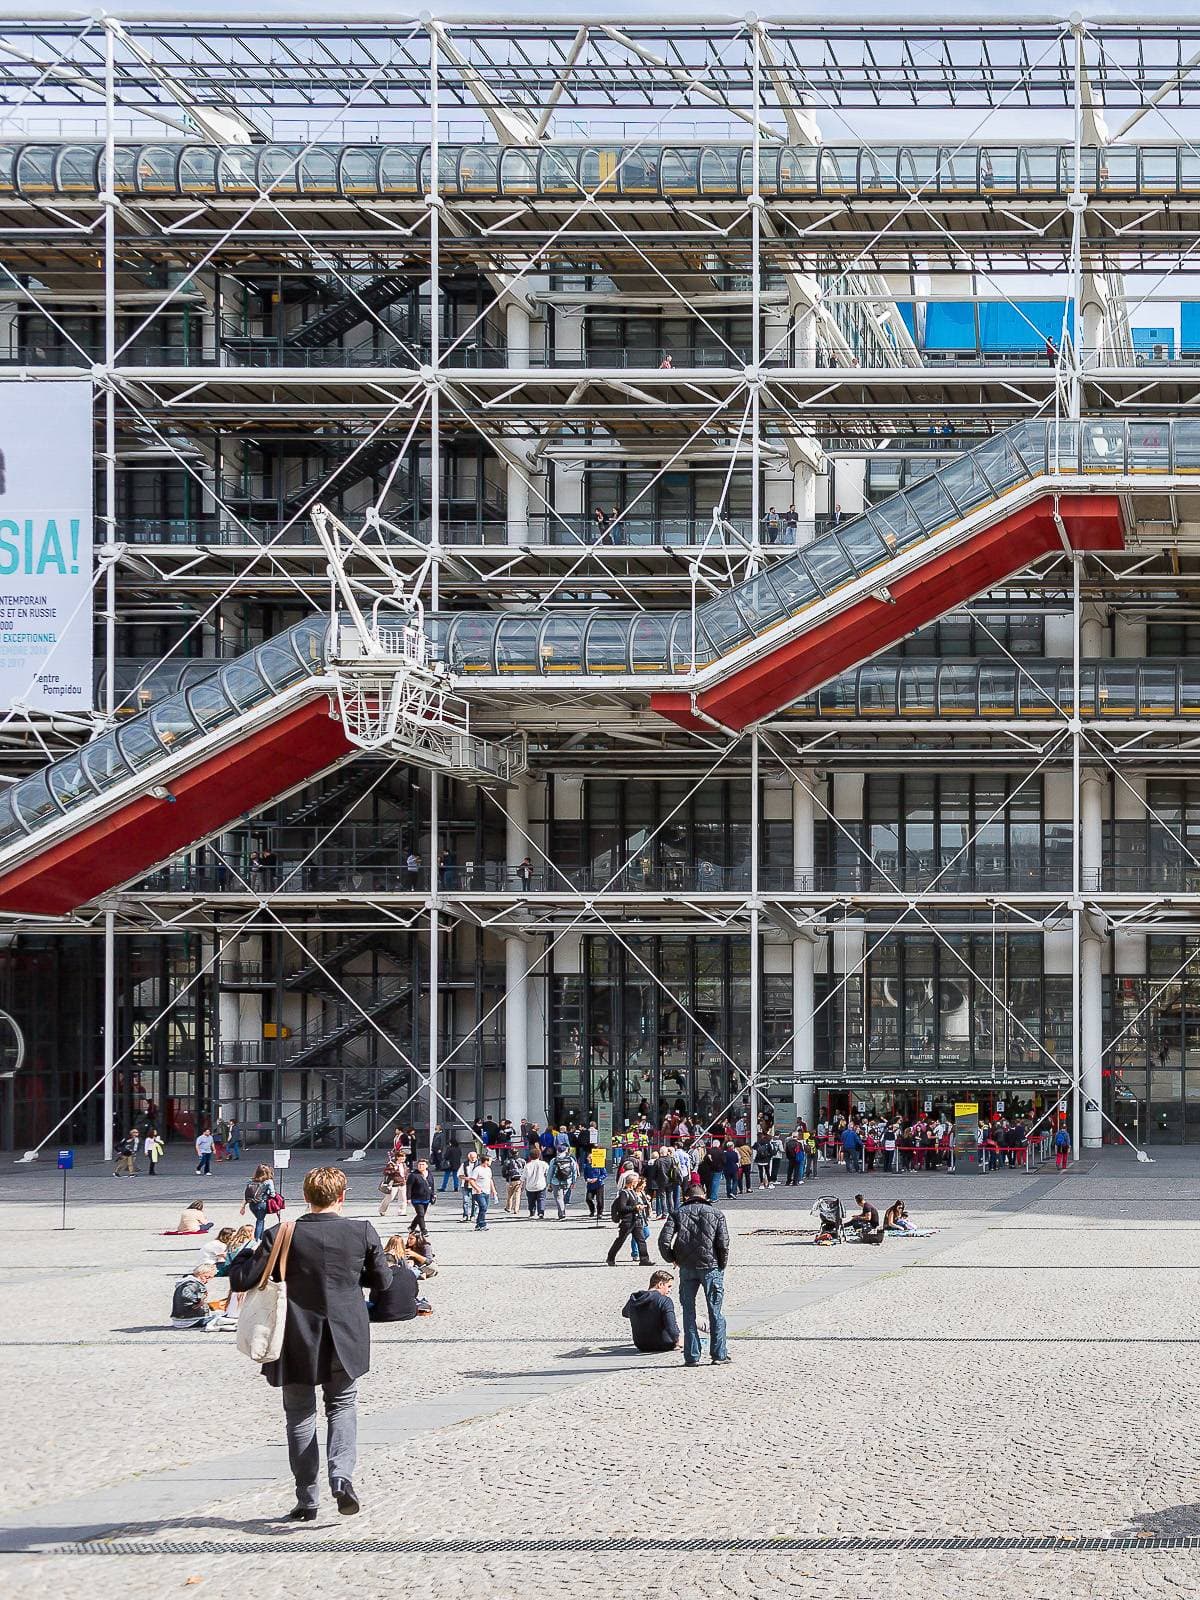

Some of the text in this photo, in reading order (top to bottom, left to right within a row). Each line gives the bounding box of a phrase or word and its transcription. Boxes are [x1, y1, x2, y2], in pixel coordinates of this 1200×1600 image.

[29, 608, 57, 618] RUSSIE
[3, 633, 57, 643] EXCEPTIONNEL
[43, 684, 82, 697] Pompidou
